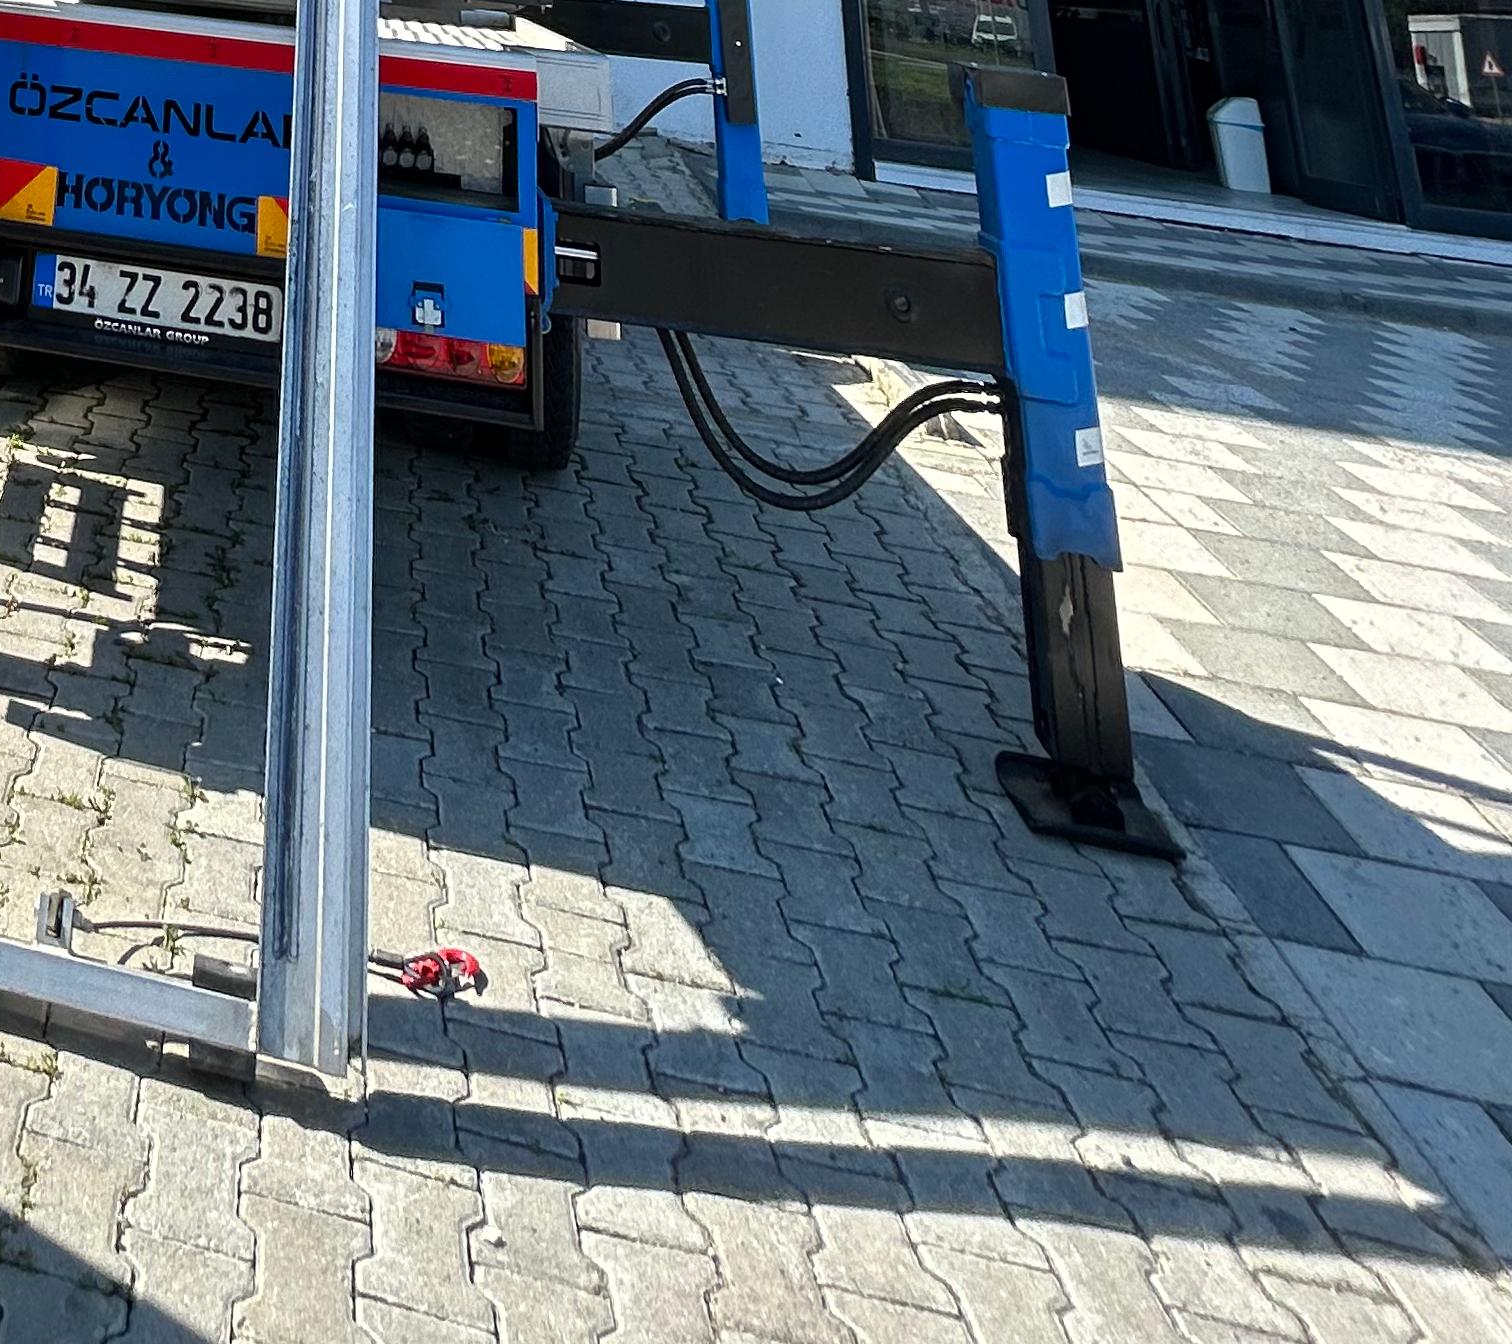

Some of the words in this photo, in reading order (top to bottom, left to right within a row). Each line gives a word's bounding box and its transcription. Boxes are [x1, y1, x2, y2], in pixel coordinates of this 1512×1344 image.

[9, 72, 292, 150] ÖZCANLA
[148, 139, 174, 179] &
[38, 283, 53, 299] TR
[56, 260, 97, 309] 34
[117, 269, 163, 320] ZZ
[180, 280, 274, 335] 2238
[93, 317, 163, 340] ÖZCANLAR
[165, 329, 210, 346] GROUP
